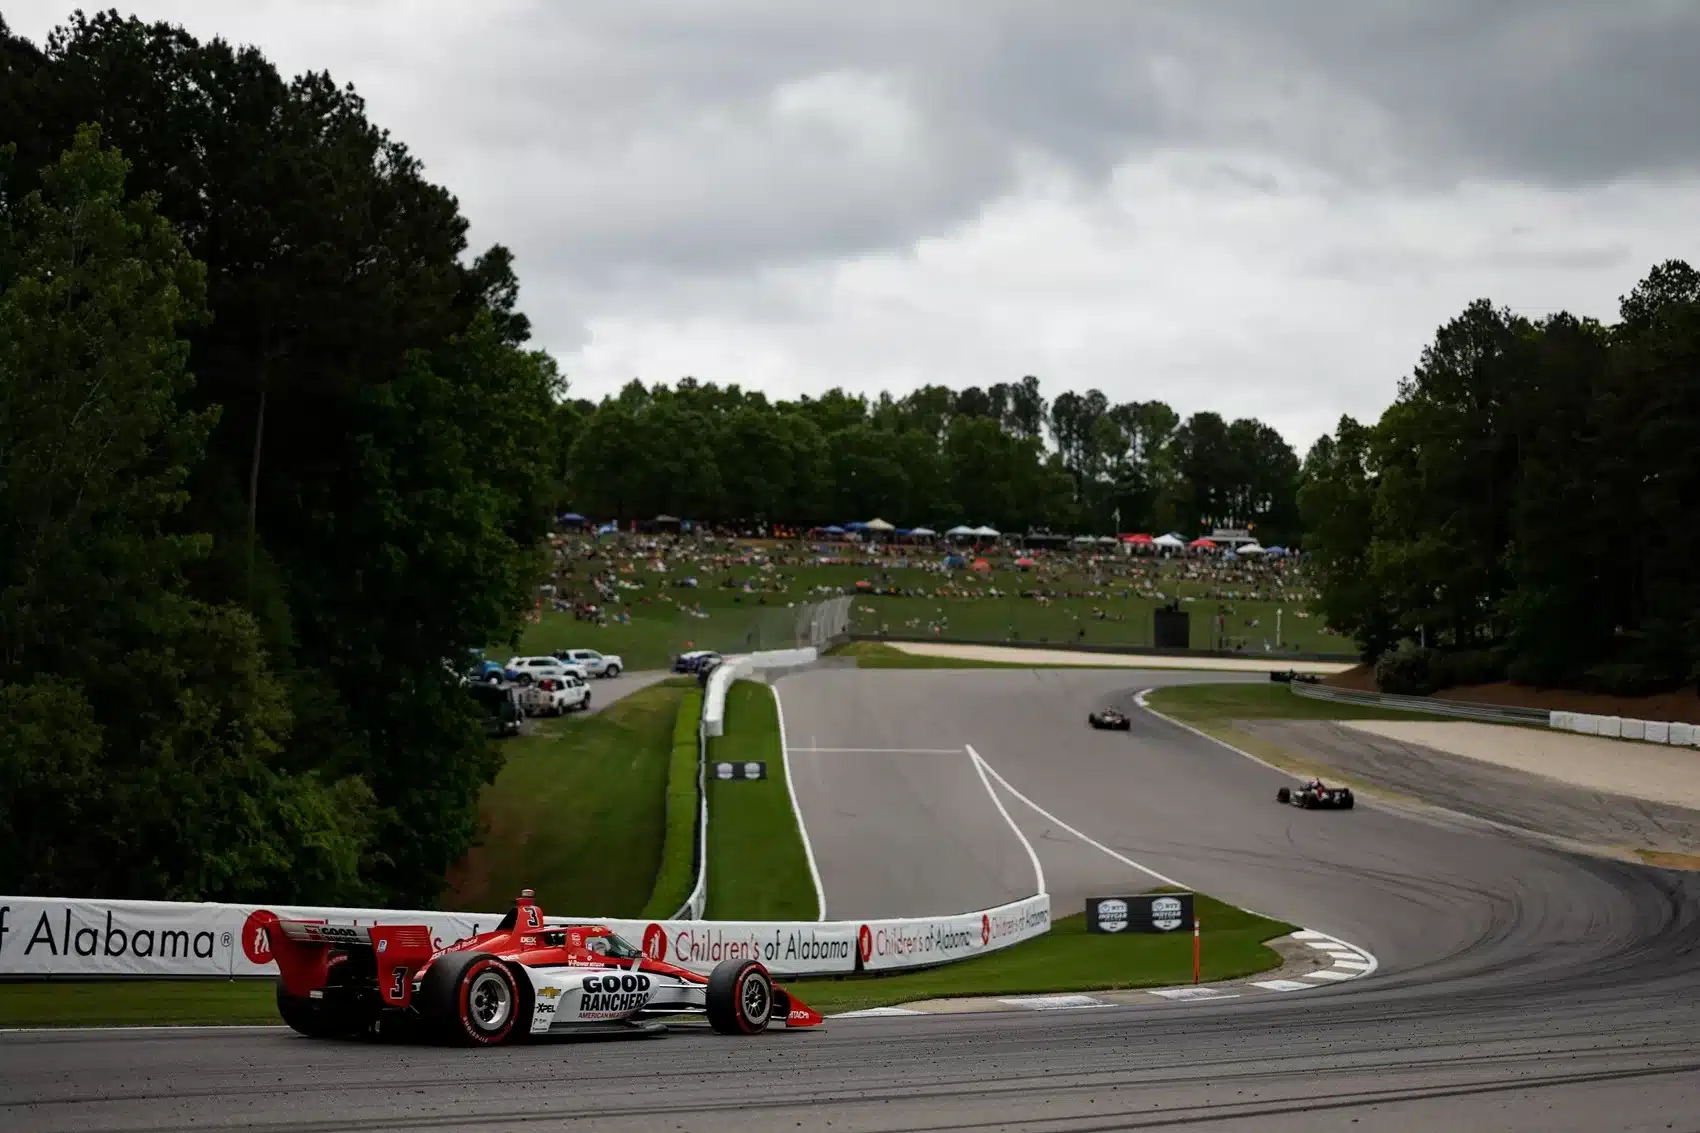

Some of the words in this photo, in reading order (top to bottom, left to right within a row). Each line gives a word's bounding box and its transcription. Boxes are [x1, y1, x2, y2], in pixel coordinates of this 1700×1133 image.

[522, 906, 540, 928] 3
[675, 929, 760, 962] Children's
[764, 929, 781, 961] of
[785, 929, 849, 960] Alabama
[389, 966, 409, 1000] 3
[582, 974, 651, 994] GOOD
[579, 993, 649, 1012] RANCHERS
